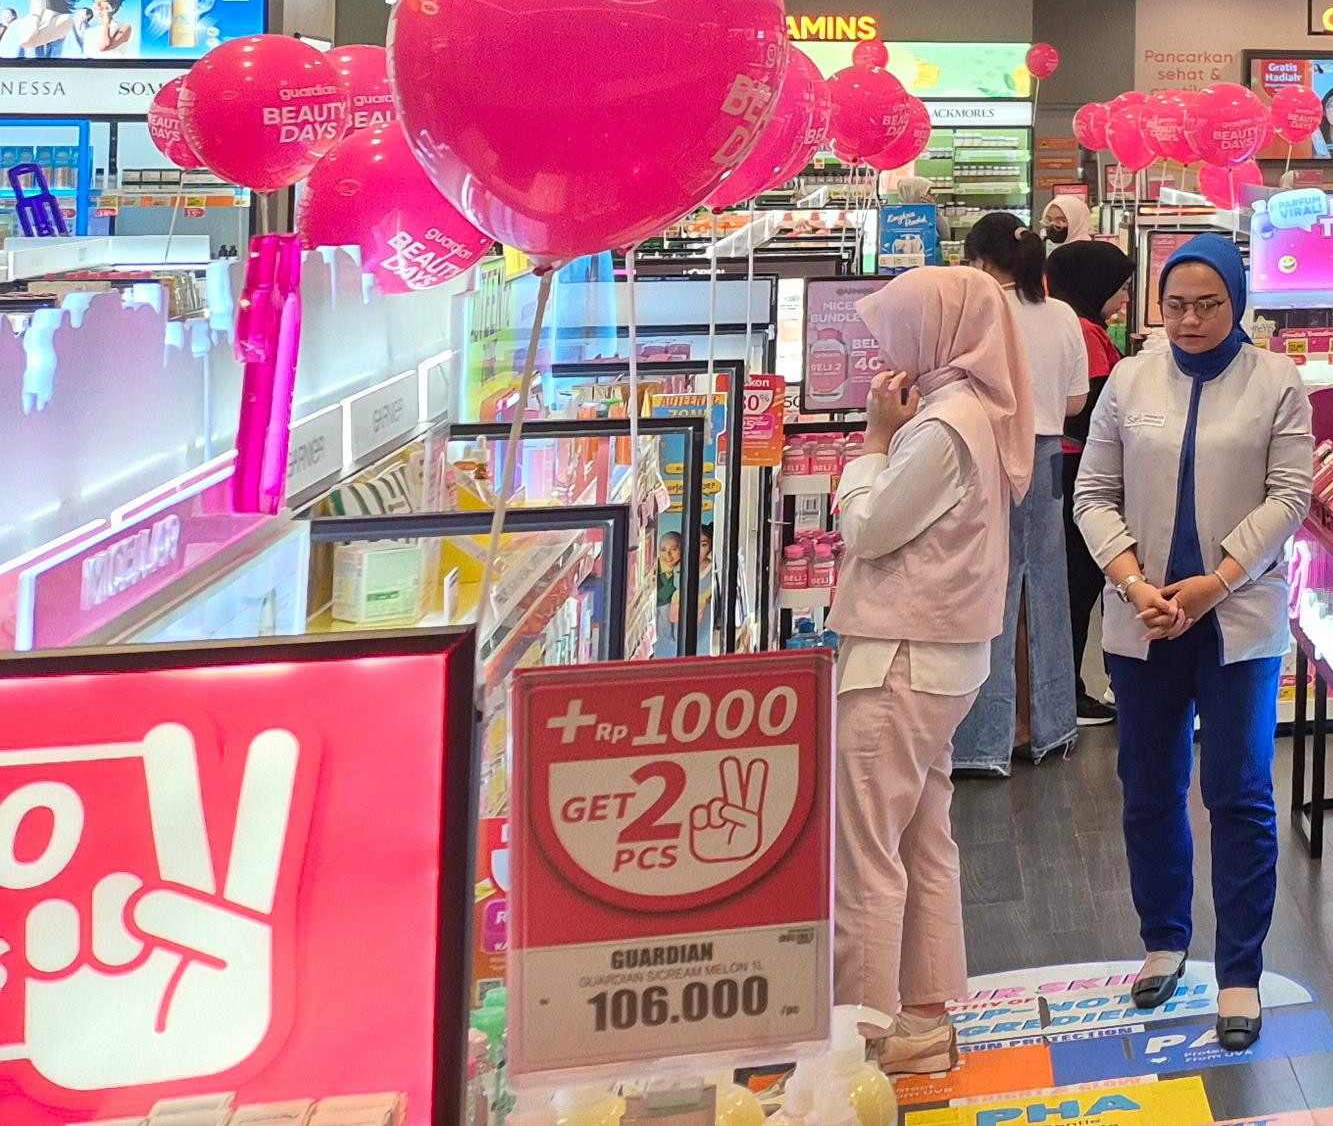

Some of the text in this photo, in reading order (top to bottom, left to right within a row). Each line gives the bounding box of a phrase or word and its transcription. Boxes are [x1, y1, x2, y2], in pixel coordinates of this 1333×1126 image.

[786, 16, 877, 40] AMINS
[1144, 49, 1233, 65] Pancarkan
[1268, 63, 1298, 73] Gratis
[1157, 68, 1220, 81] sehat &
[280, 84, 337, 101] guardian
[263, 101, 346, 127] BEAUTY
[930, 107, 996, 121] ACKMORES
[280, 121, 338, 144] DAYS
[1213, 129, 1258, 141] BEAUTY
[1222, 139, 1254, 150] DAYS
[387, 231, 459, 280] BEAUTY
[561, 760, 687, 845] GET 2
[613, 845, 679, 872] PCS
[611, 942, 714, 970] GUARDIAN
[706, 962, 749, 977] MELON
[587, 975, 769, 1032] 106.000
[959, 1026, 1135, 1053] SUN PROTECTION
[976, 1094, 1141, 1126] PHA
